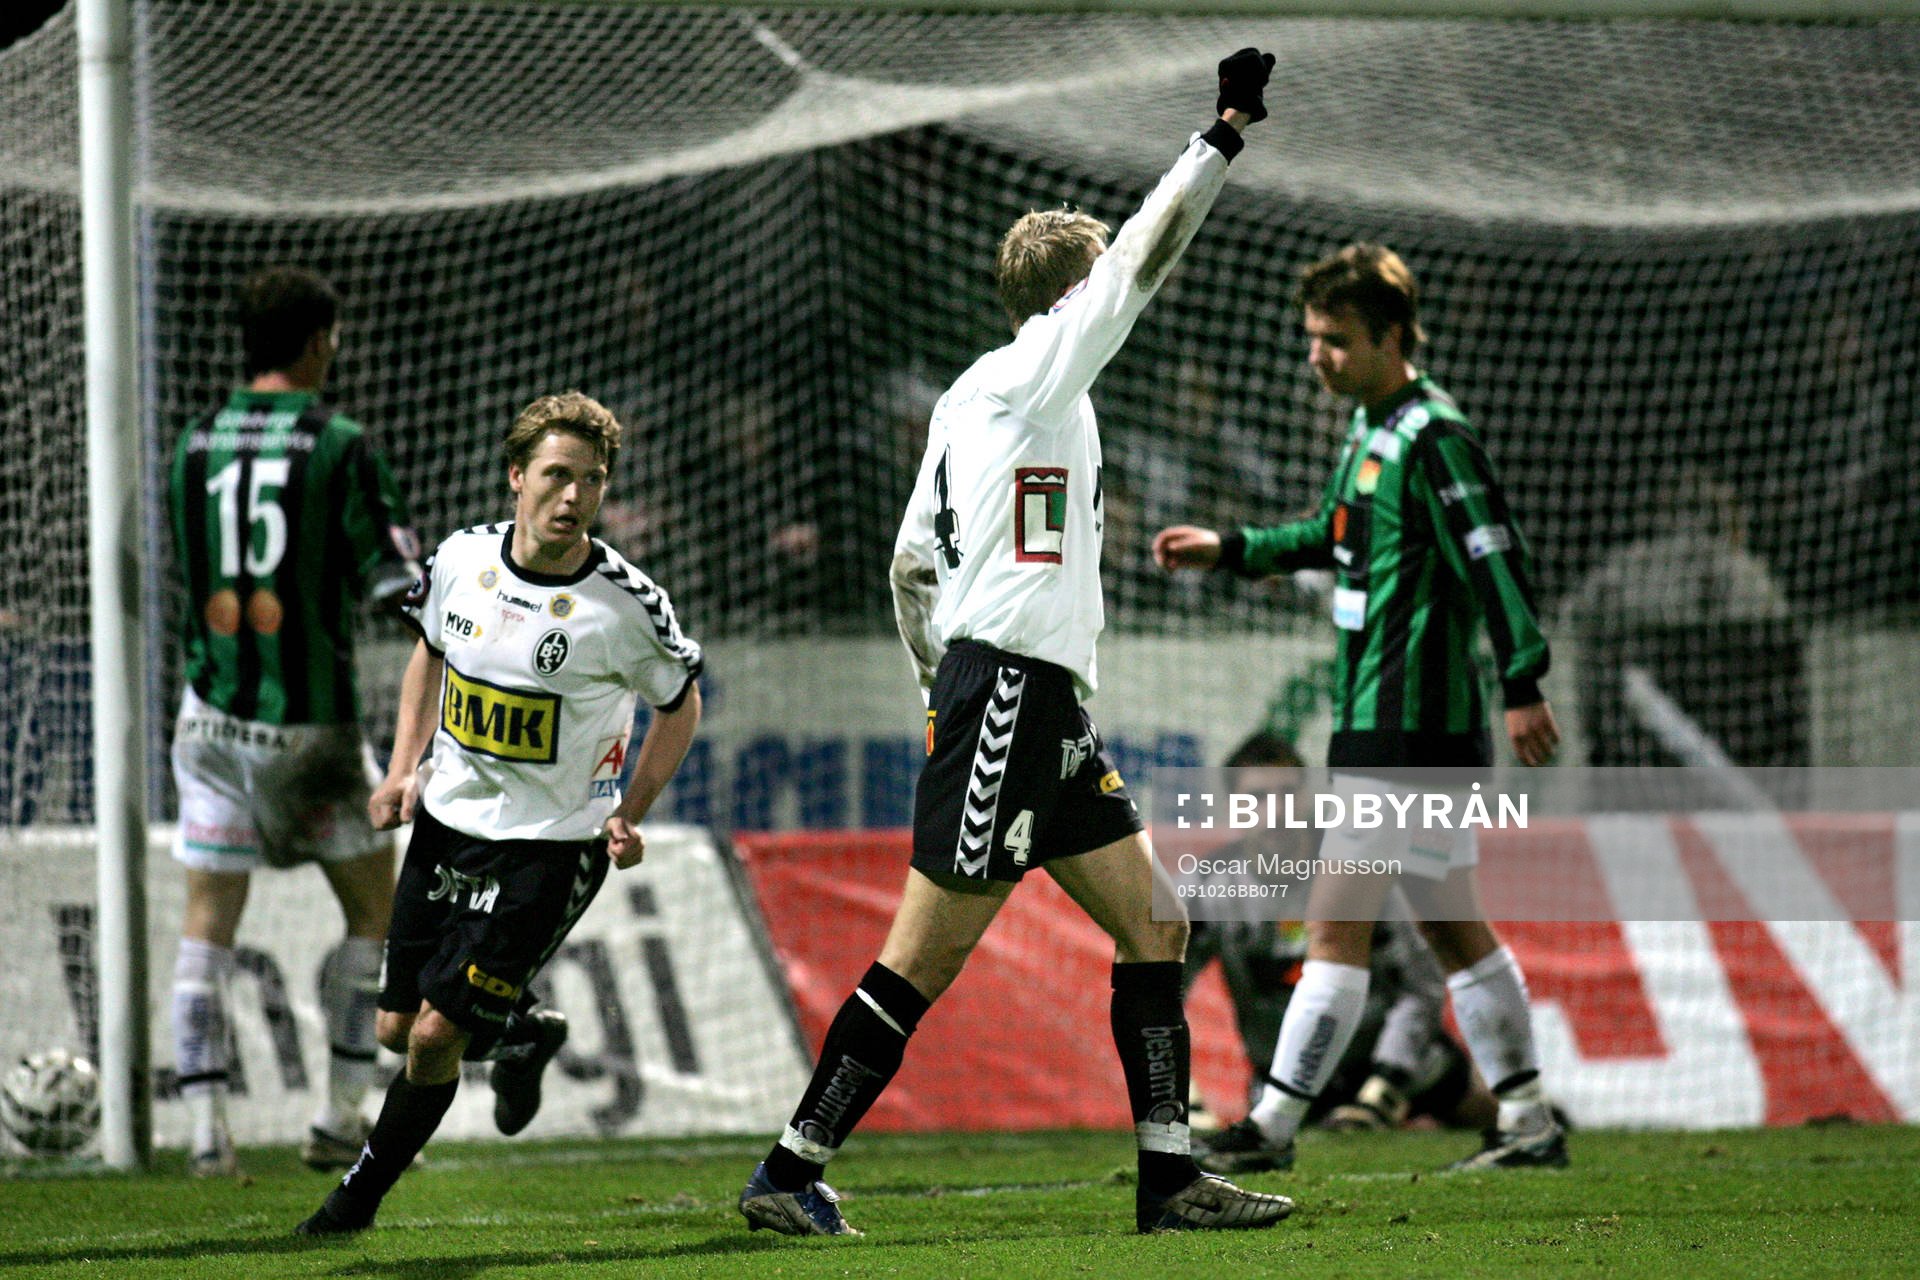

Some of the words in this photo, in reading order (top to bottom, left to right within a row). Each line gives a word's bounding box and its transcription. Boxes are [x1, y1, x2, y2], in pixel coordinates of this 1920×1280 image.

[206, 457, 291, 578] 15
[446, 611, 474, 636] MVB
[496, 589, 543, 613] hummel
[448, 681, 546, 749] BMK
[1003, 808, 1035, 867] 4
[814, 1054, 883, 1130] besam
[1140, 1025, 1184, 1099] besam
